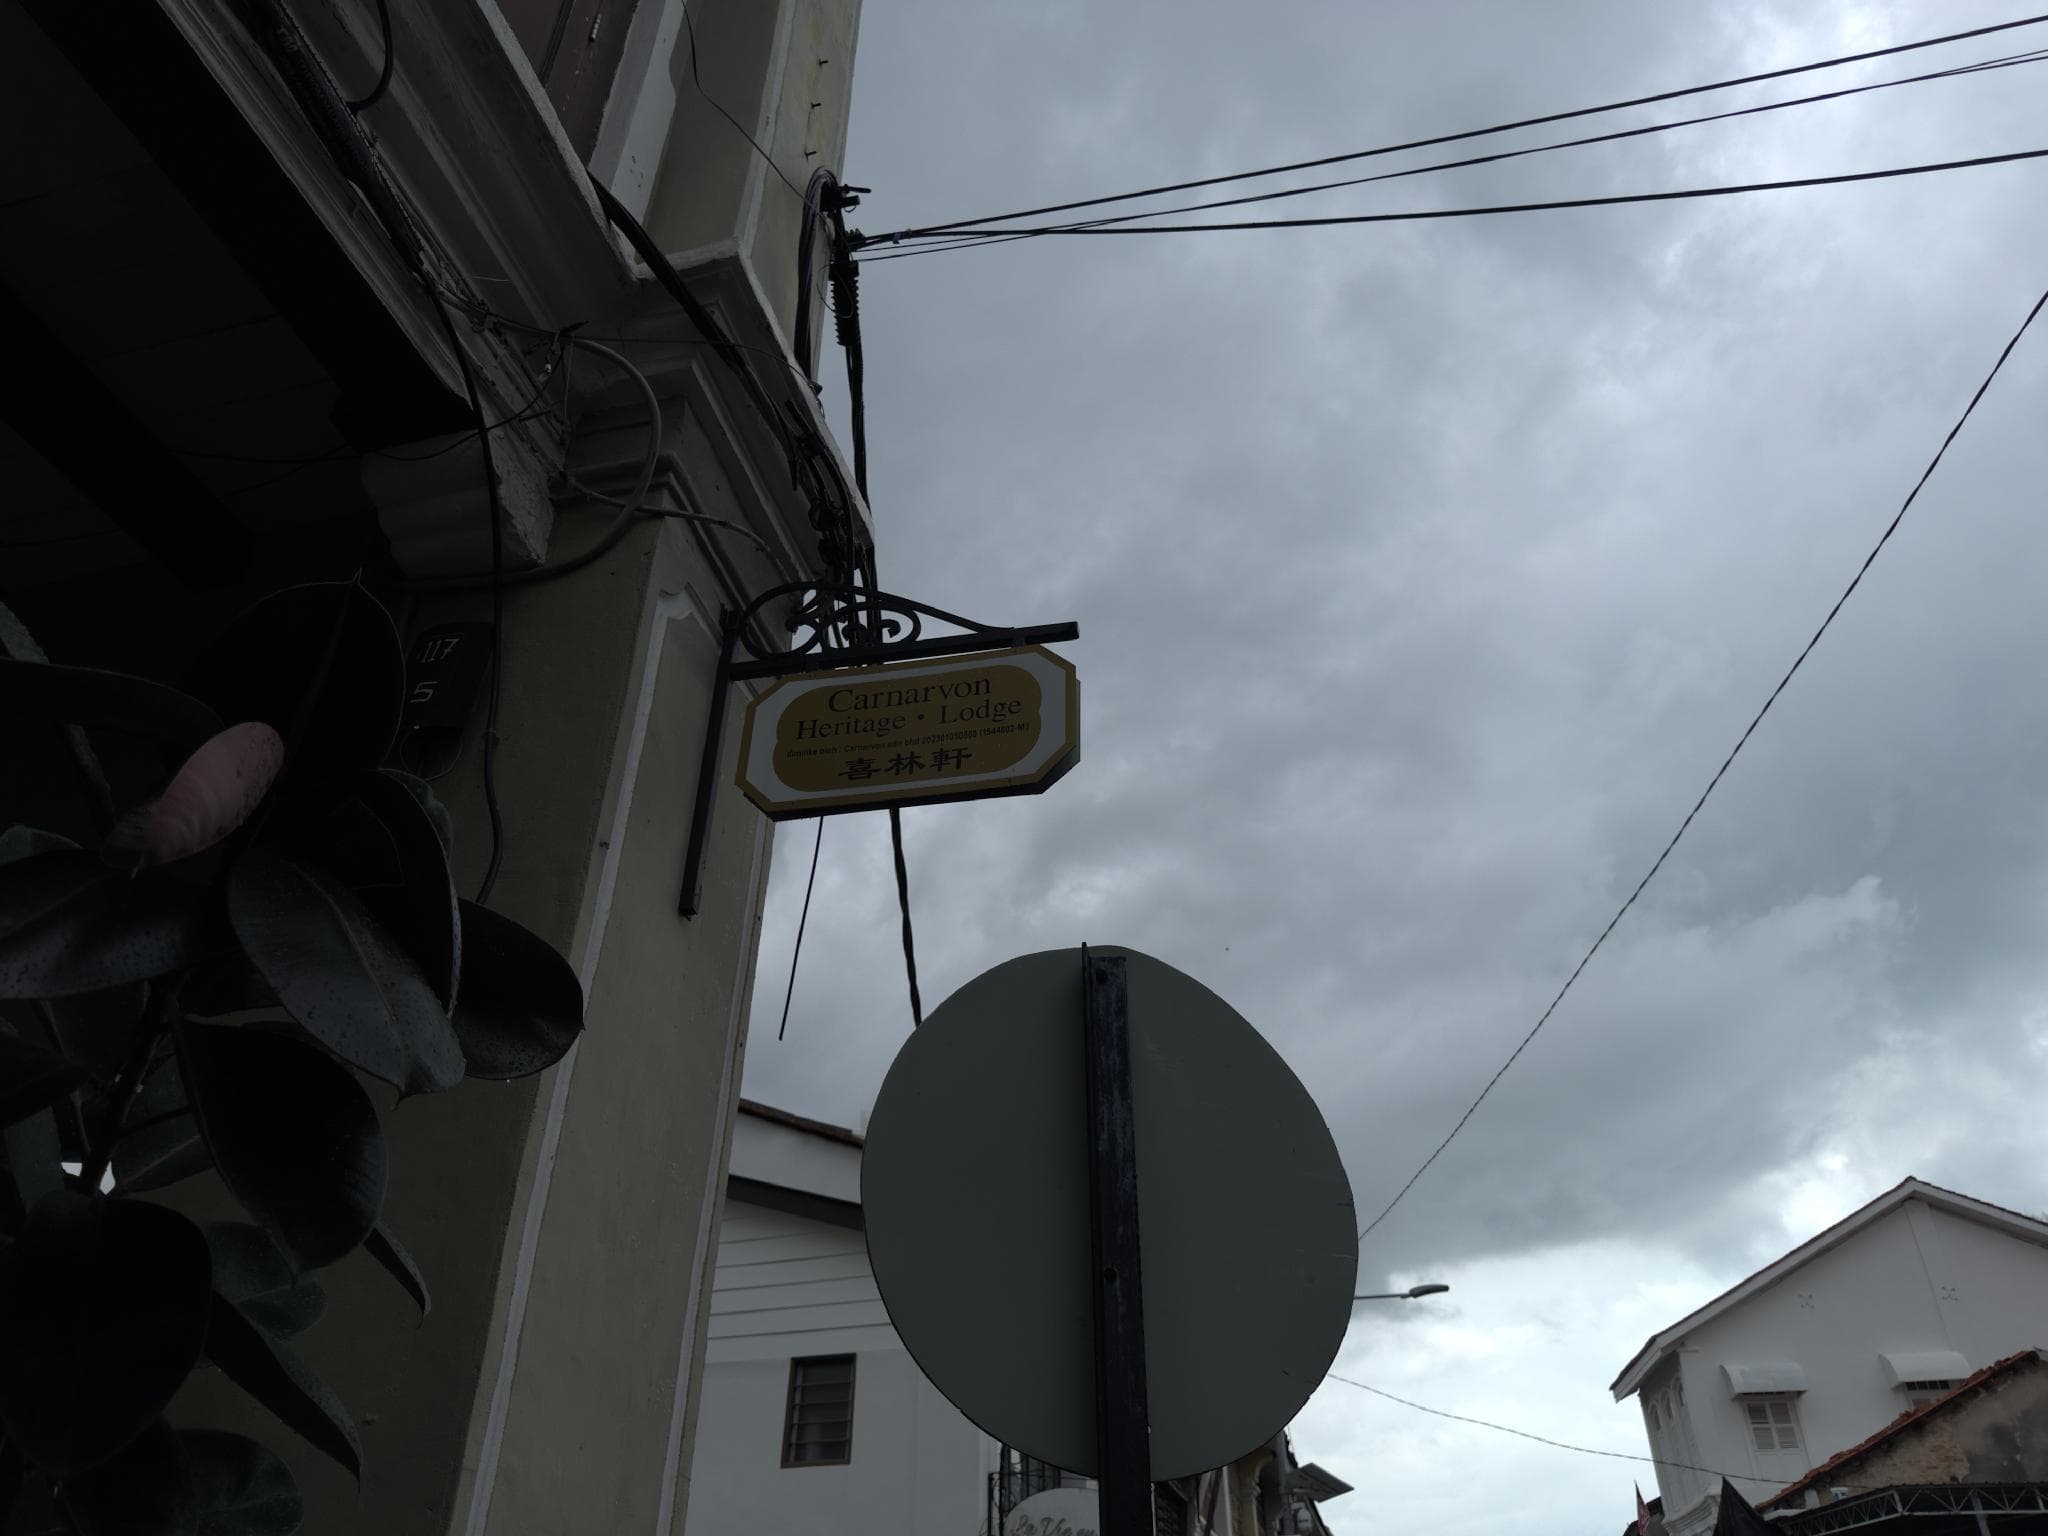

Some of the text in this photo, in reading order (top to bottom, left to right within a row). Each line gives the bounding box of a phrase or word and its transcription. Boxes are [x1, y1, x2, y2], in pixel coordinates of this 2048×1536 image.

[828, 677, 992, 713] Carnarvon
[796, 697, 1021, 740] Heritage Lodge
[837, 747, 973, 782] 喜林軒
